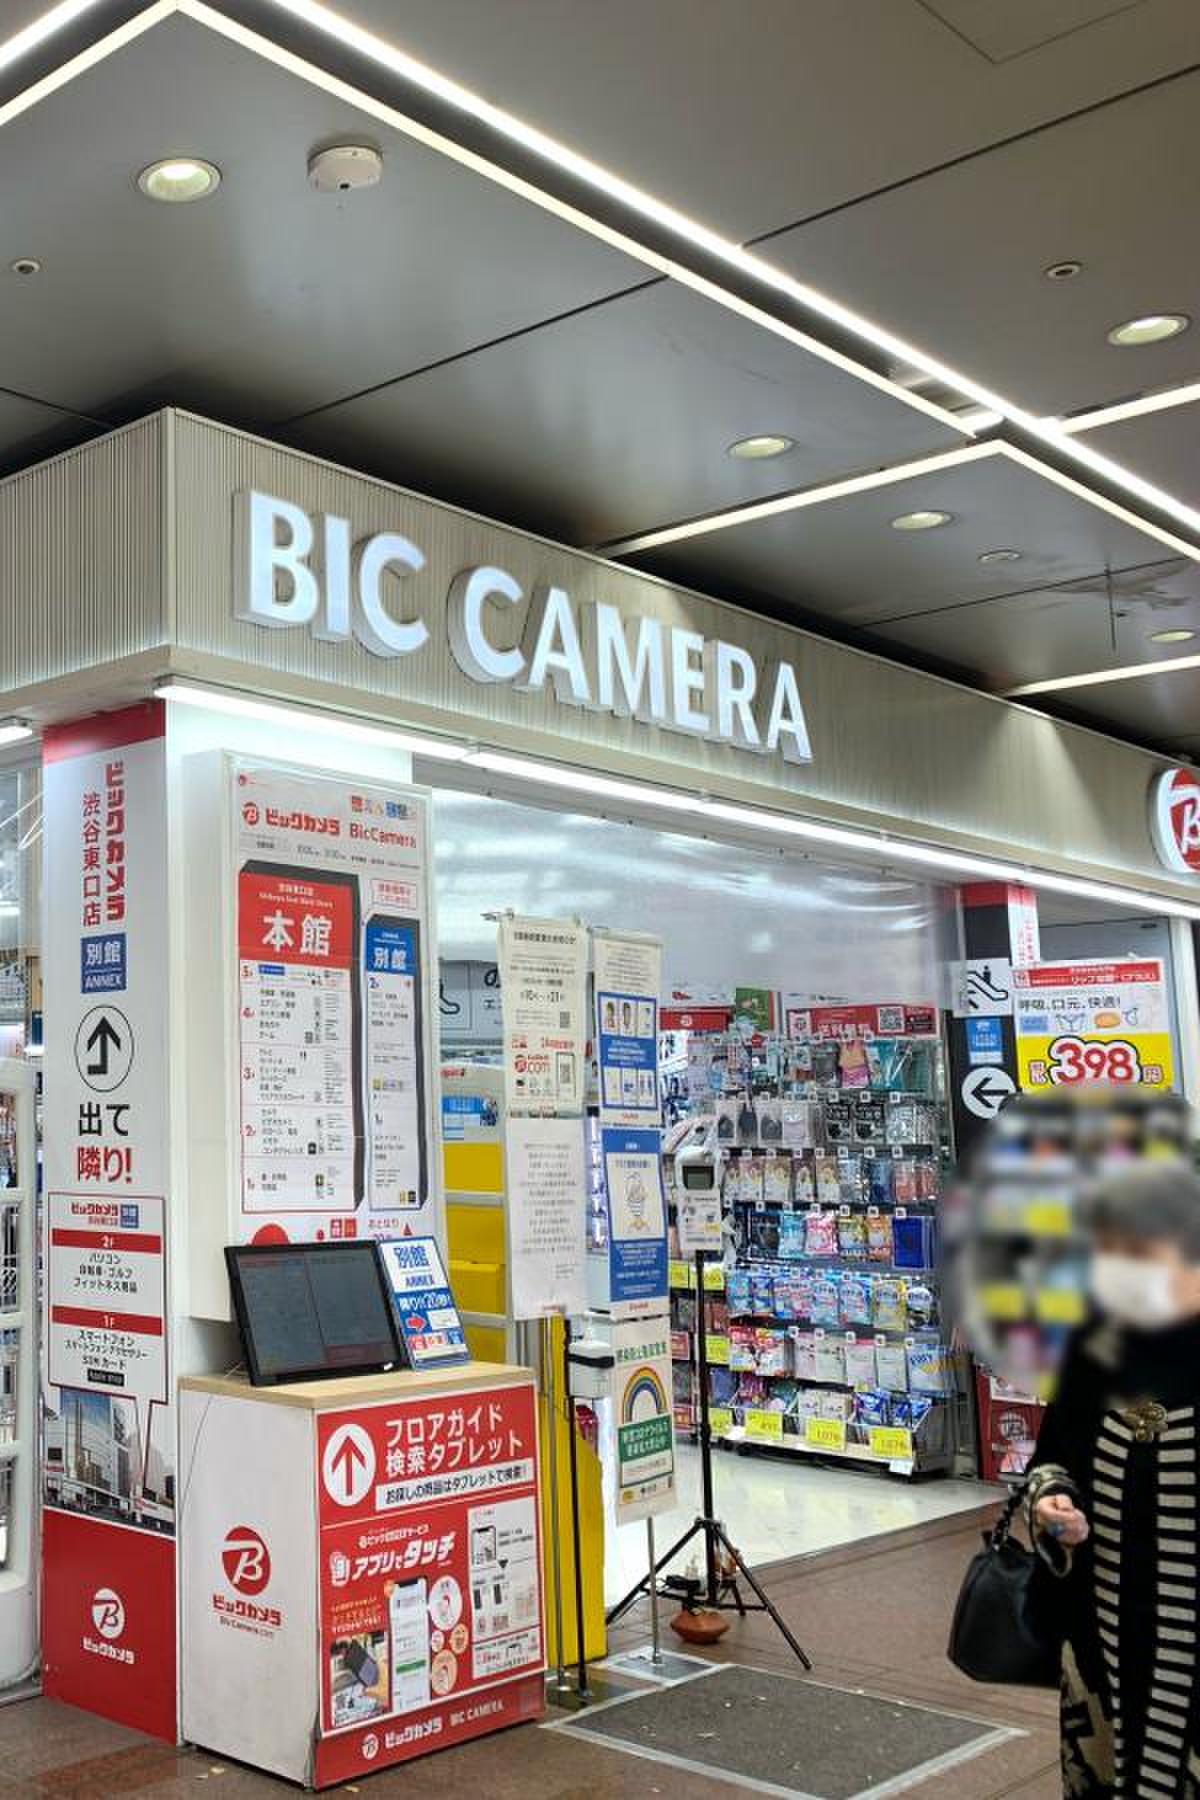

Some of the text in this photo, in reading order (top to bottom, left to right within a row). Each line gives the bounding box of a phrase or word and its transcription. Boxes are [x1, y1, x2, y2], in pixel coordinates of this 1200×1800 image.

[236, 489, 813, 765] BIC CAMERA
[266, 807, 340, 836] ビックカメラ
[105, 760, 125, 921] ビックカメラ
[82, 792, 101, 927] 渋谷東口店
[262, 910, 333, 957] 本館
[85, 942, 121, 965] 別館
[373, 947, 406, 969] 別館
[84, 973, 122, 989] ANNEX
[1056, 1041, 1133, 1084] 398
[79, 1102, 130, 1136] 出て
[78, 1145, 132, 1183] 隣り!
[386, 1404, 503, 1448] フロアガイド
[385, 1429, 523, 1478] 検索タブレット
[213, 1594, 282, 1626] ビックカメラ
[83, 1636, 135, 1664] ビックカメラ
[385, 1717, 442, 1748] ビックカメラ
